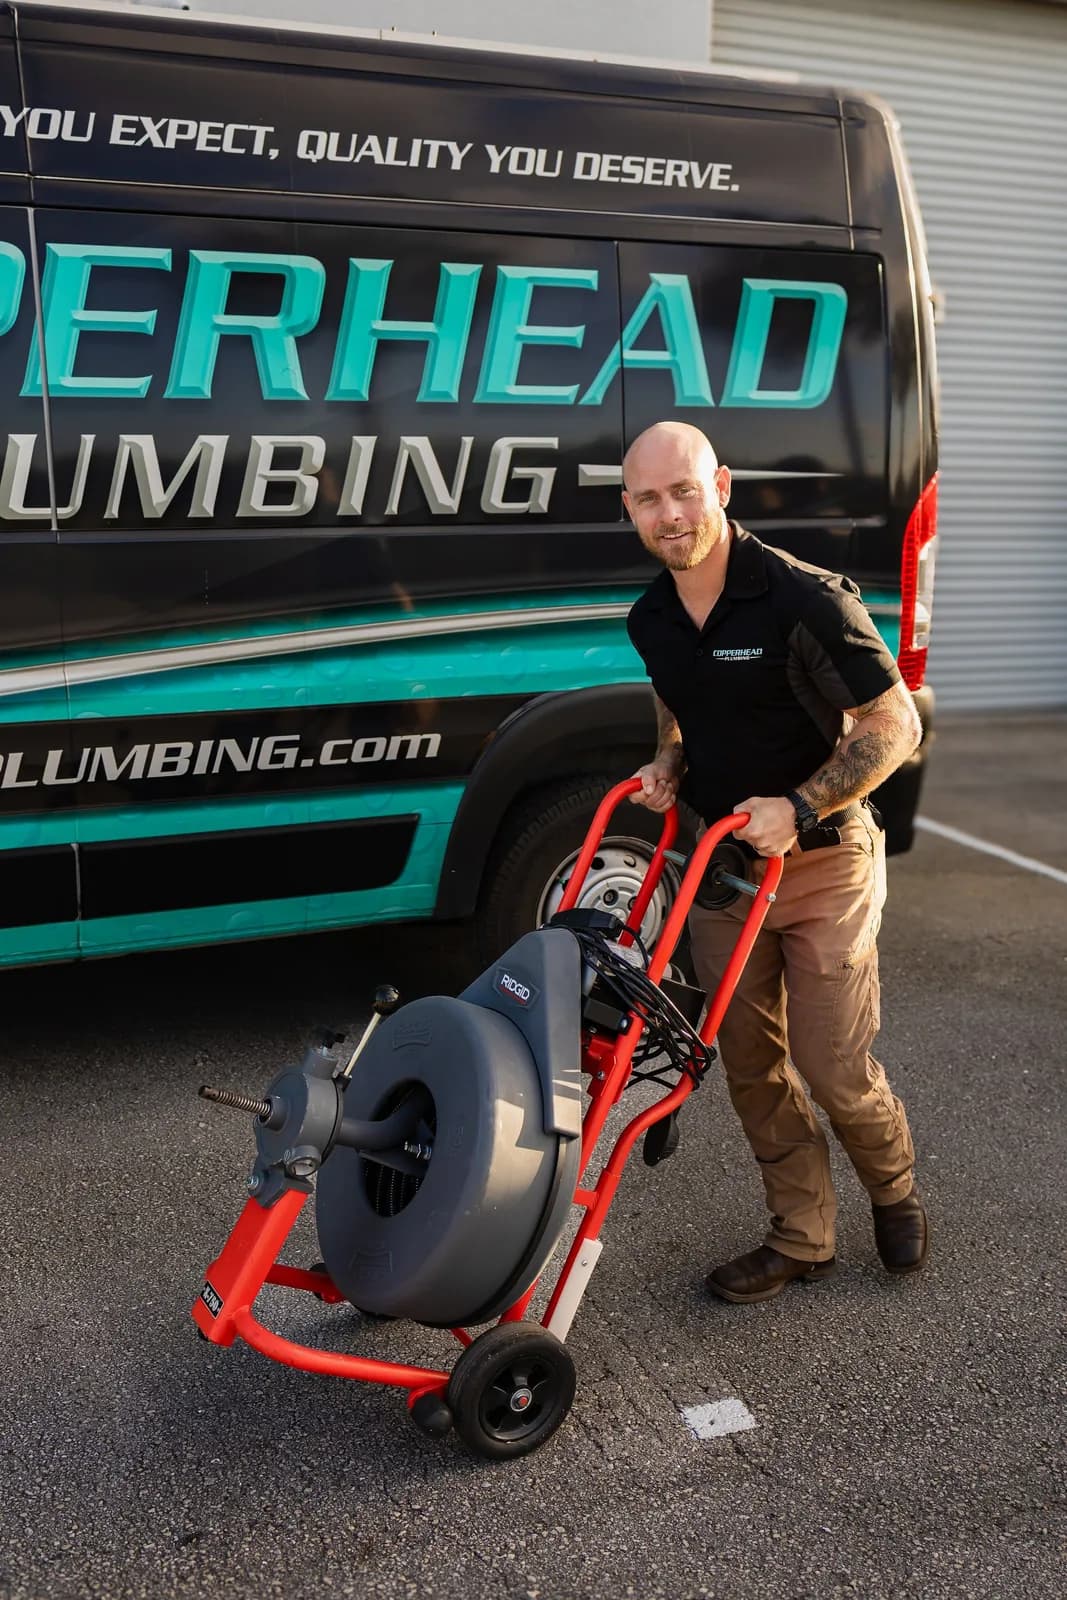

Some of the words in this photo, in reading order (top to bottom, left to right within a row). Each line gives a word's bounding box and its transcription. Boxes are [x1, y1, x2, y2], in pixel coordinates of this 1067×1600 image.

[0, 105, 95, 142] YOU
[109, 114, 279, 160] EXPECT,
[296, 130, 474, 171] QUALITY
[485, 144, 563, 177] YOU
[573, 151, 740, 192] DESERVE.
[0, 241, 848, 408] ERHEAD
[713, 648, 763, 657] COPPERHEAD
[0, 733, 442, 789] LUMBING.com
[500, 973, 530, 1001] RIDGID
